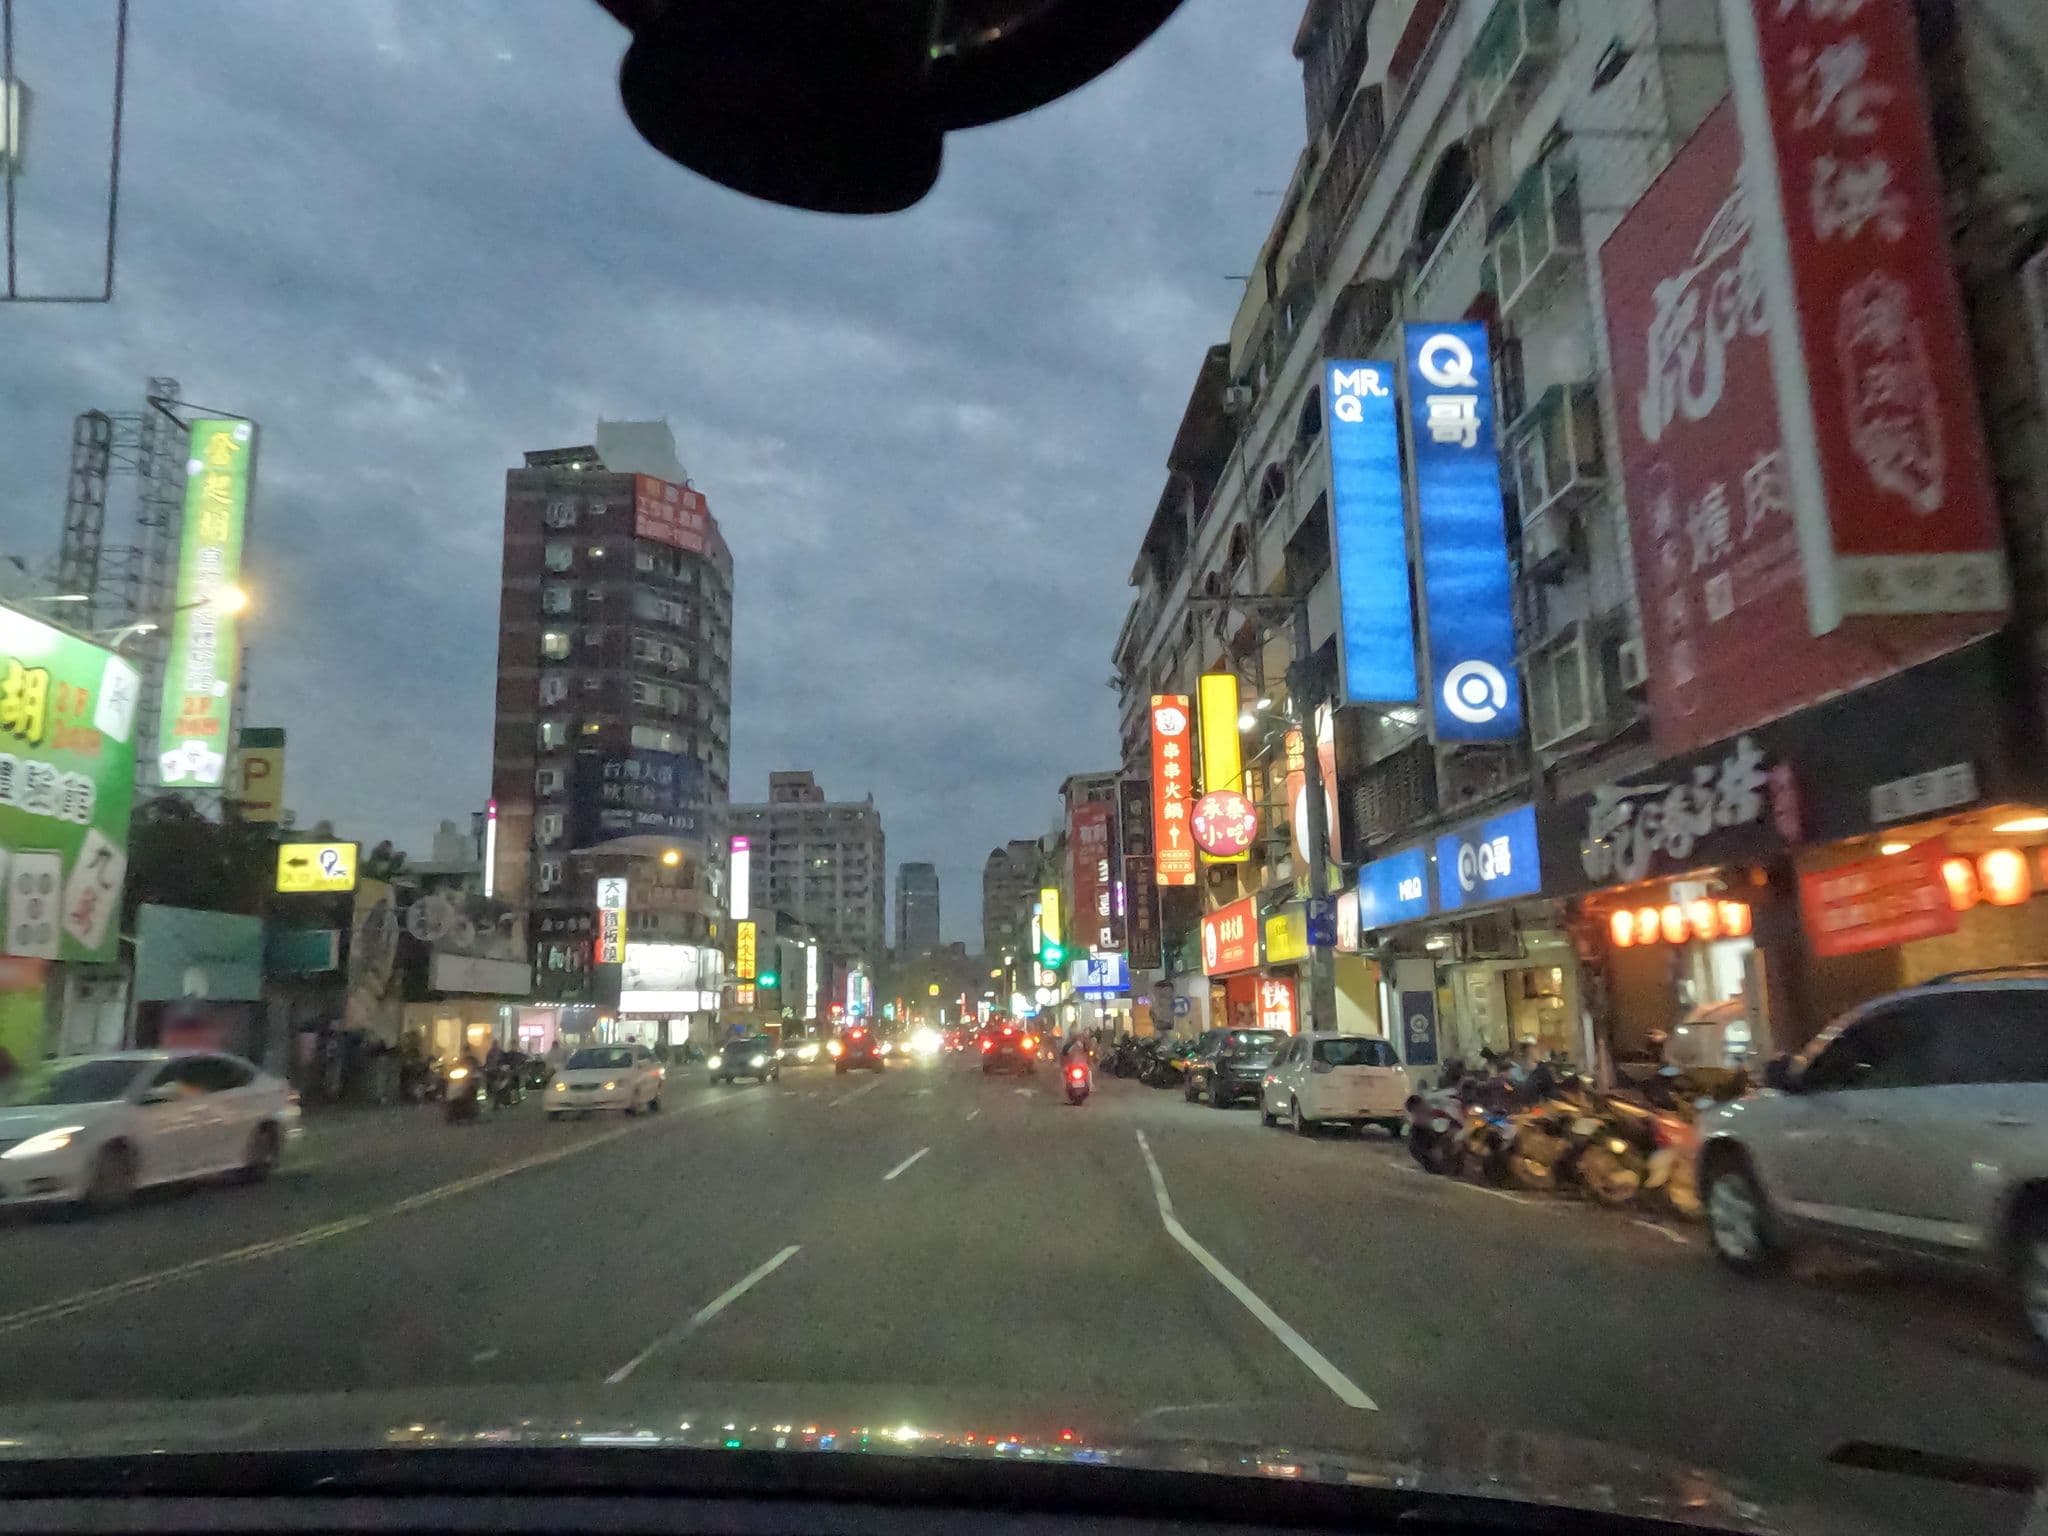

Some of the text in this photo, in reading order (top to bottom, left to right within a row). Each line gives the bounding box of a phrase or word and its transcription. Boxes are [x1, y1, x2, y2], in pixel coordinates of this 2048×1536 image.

[1333, 368, 1389, 397] MR.
[1335, 395, 1364, 422] Q
[244, 757, 271, 791] P
[1162, 741, 1184, 820] 串串火鍋
[1202, 823, 1249, 847] 小吃
